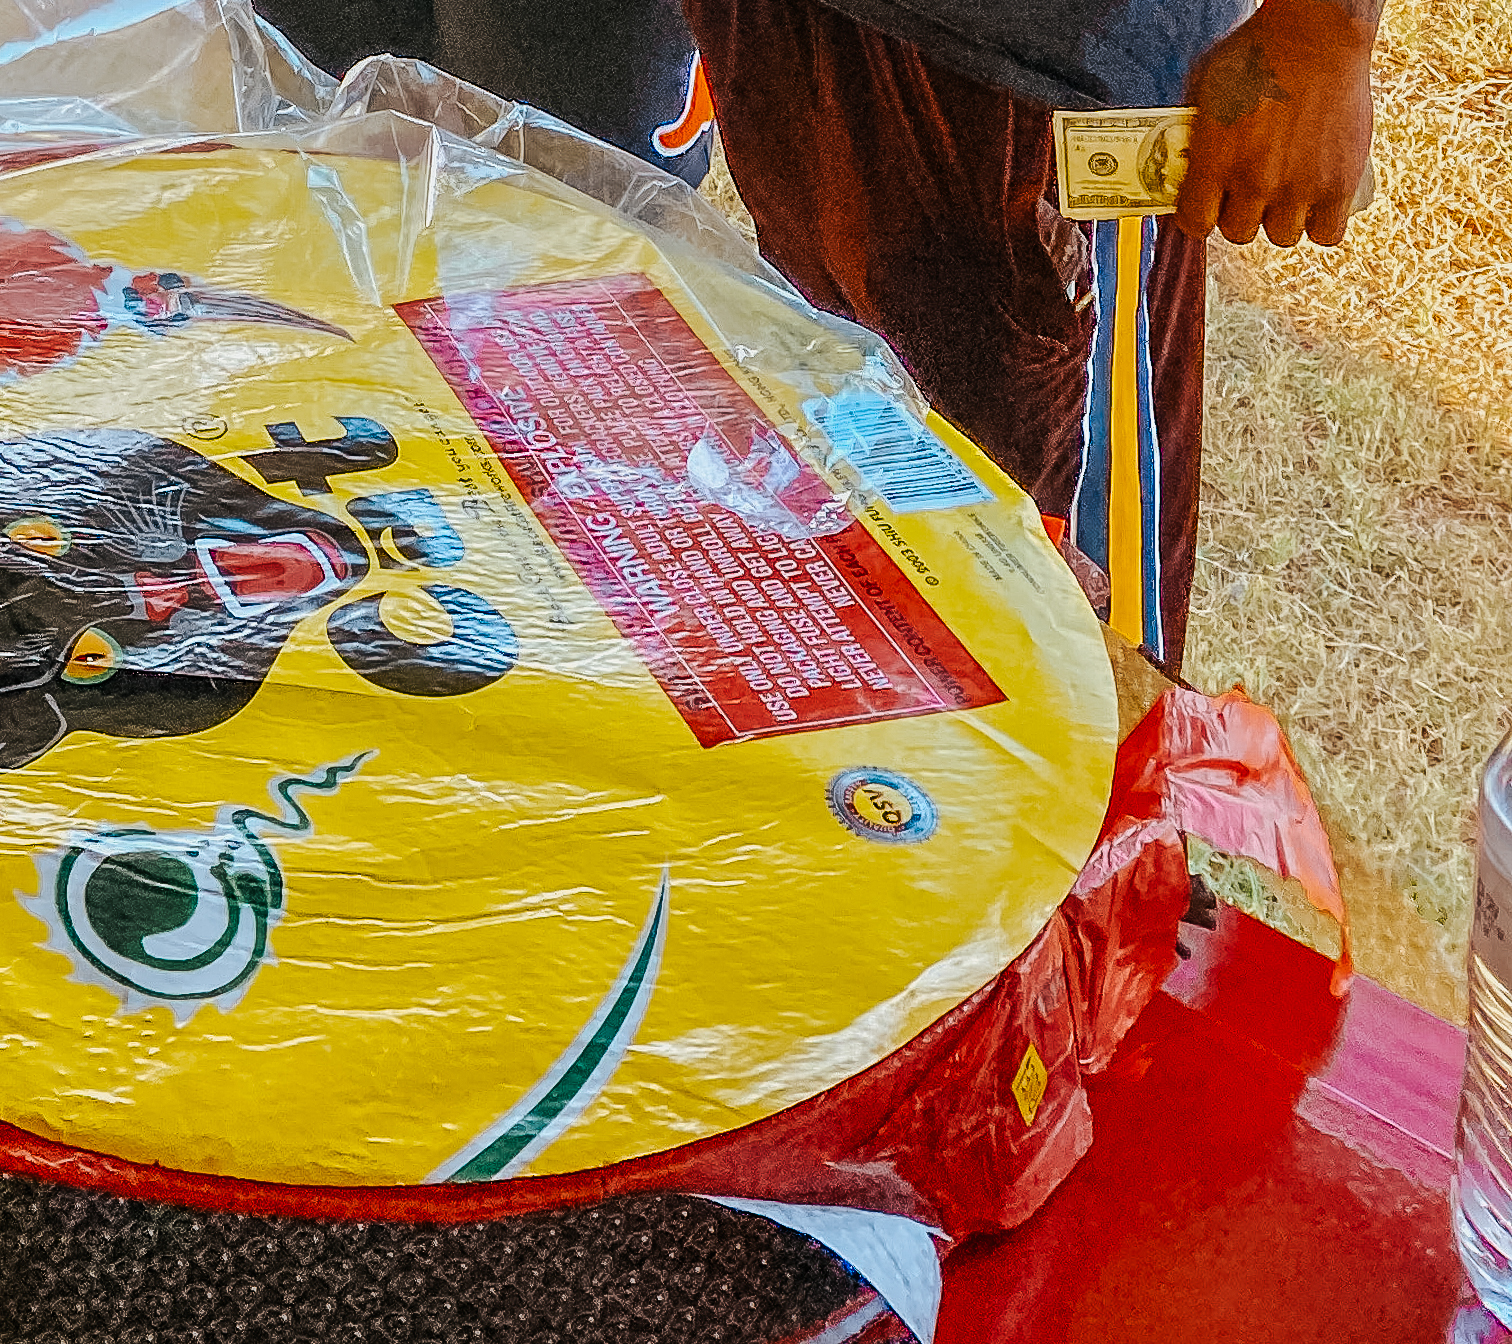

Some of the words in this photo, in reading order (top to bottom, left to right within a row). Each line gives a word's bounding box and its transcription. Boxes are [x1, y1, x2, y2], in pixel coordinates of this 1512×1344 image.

[506, 352, 560, 406] OUTDOOR
[581, 349, 631, 396] RELIGHT
[617, 364, 664, 407] CLOSED
[574, 376, 614, 408] PACK
[617, 397, 644, 413] TO
[546, 408, 580, 434] FOR
[598, 410, 644, 446] PLACE
[438, 445, 470, 470] you
[488, 386, 597, 499] EXPLOSIVE
[631, 416, 685, 466] ATTEMPT
[626, 518, 675, 560] ADULT
[662, 527, 695, 548] OR
[688, 522, 746, 578] UNROLL
[875, 522, 908, 547] SHIU
[250, 414, 519, 697] Cat
[580, 512, 687, 618] WARNING
[680, 550, 726, 588] HAND
[736, 550, 774, 577] GET
[774, 558, 804, 578] TO
[828, 542, 871, 576] EACH
[658, 561, 708, 604] CLOSE
[708, 588, 738, 604] IN
[730, 579, 770, 608] AND
[760, 578, 799, 608] AND
[806, 560, 856, 606] NEVER
[857, 577, 887, 597] OF
[692, 606, 744, 652] UNDER
[721, 605, 768, 644] HOLD
[782, 608, 828, 645] FUSE
[789, 580, 855, 642] ATTEMPT
[873, 597, 936, 655] CONTENT
[751, 644, 792, 674] NOT
[754, 609, 832, 688] PACKAGING
[812, 647, 862, 688] LIGHT
[837, 641, 892, 688] NEVER
[728, 654, 774, 690] ONLY
[775, 675, 809, 697] DO
[920, 656, 973, 704] POWDER
[756, 690, 796, 719] USE
[861, 787, 902, 832] QSV
